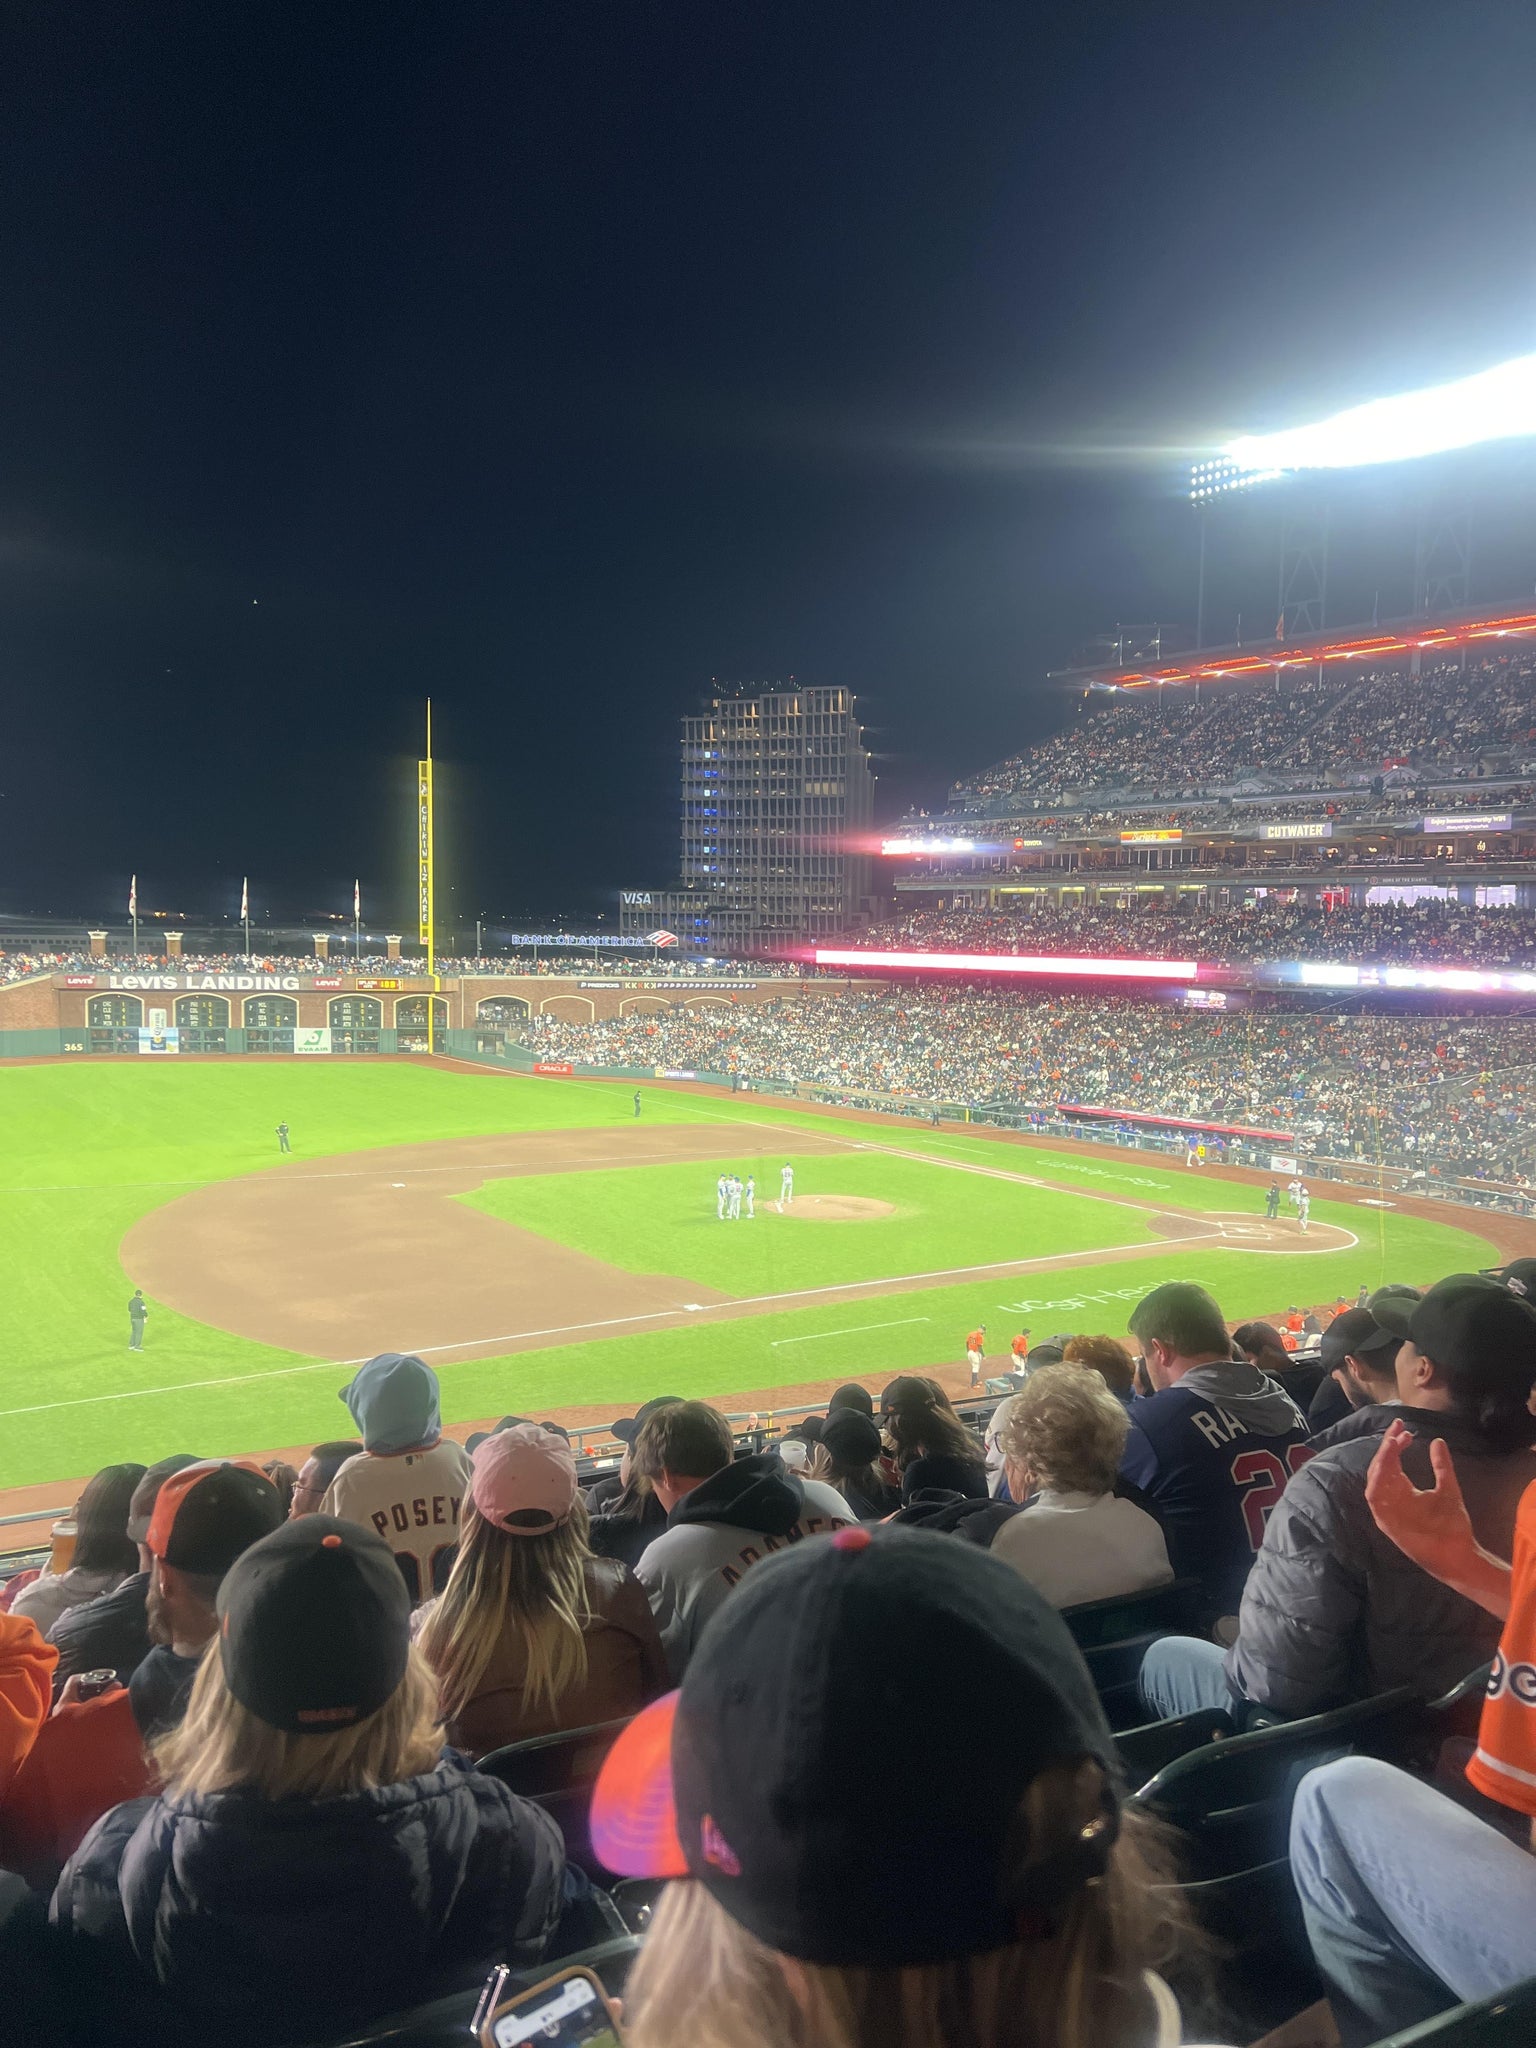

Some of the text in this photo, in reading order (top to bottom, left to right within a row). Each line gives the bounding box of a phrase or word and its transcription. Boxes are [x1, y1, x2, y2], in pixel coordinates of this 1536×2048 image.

[1267, 824, 1324, 838] CUTWATER
[623, 892, 652, 905] VISA
[511, 934, 645, 947] BANK OF AMERICA
[186, 975, 300, 990] LANDING
[64, 1043, 84, 1052] 365
[410, 1043, 429, 1052] 309
[998, 1297, 1086, 1313] UCSF
[371, 1496, 461, 1537] POSEY
